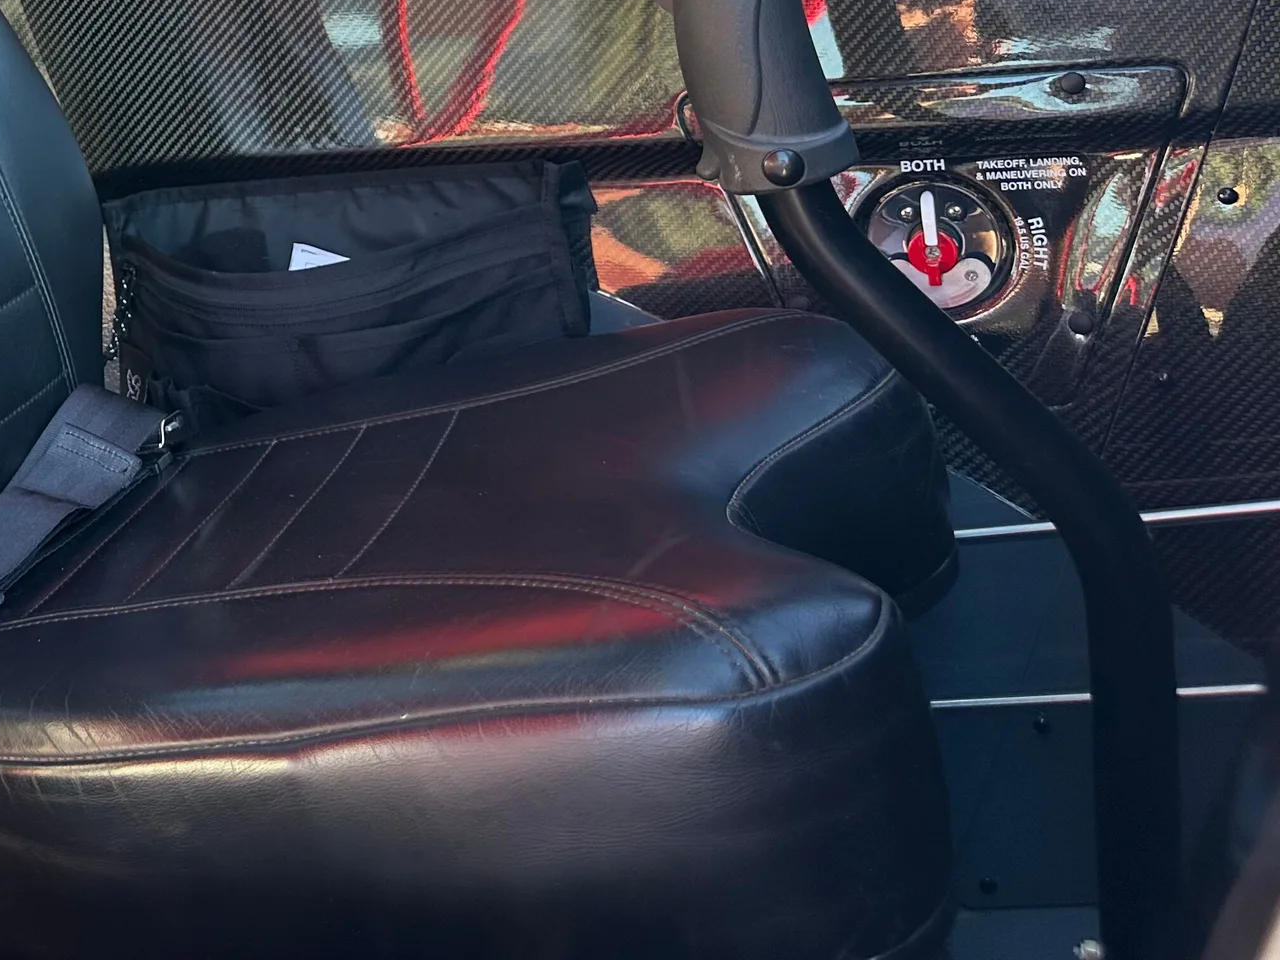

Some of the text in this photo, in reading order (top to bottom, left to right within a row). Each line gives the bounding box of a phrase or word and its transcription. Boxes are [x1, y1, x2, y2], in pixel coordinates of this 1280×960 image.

[900, 159, 945, 173] BOTH
[976, 156, 1083, 170] TAKEOFF, LANDING,
[975, 167, 1086, 181] & MANEUVERING ON
[1000, 180, 1063, 191] BOTH ONLY
[1014, 216, 1030, 270] 19.5 US GAL
[1028, 216, 1050, 271] RIGHT
